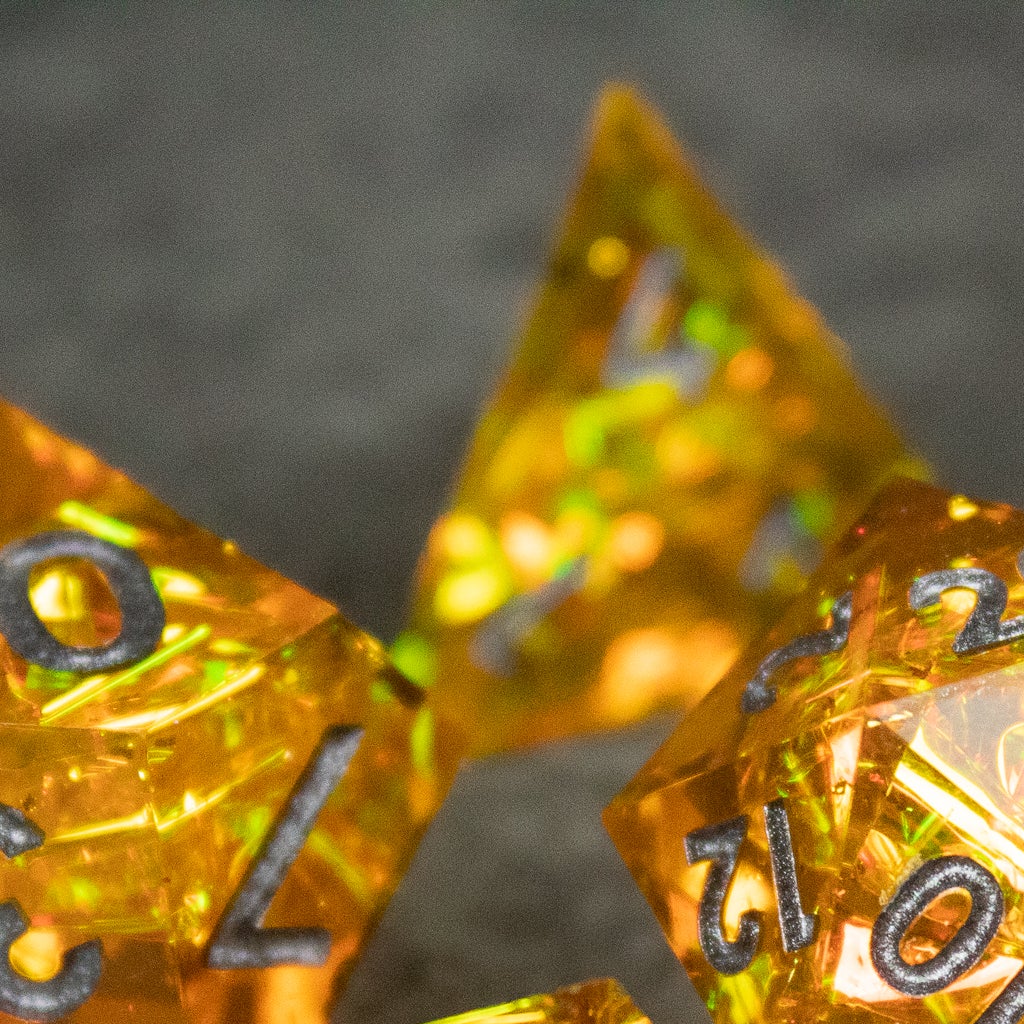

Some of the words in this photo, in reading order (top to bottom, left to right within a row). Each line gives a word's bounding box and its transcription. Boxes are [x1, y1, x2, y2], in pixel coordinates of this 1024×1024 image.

[0, 532, 165, 672] 0
[209, 725, 364, 969] 7
[684, 797, 819, 975] 12
